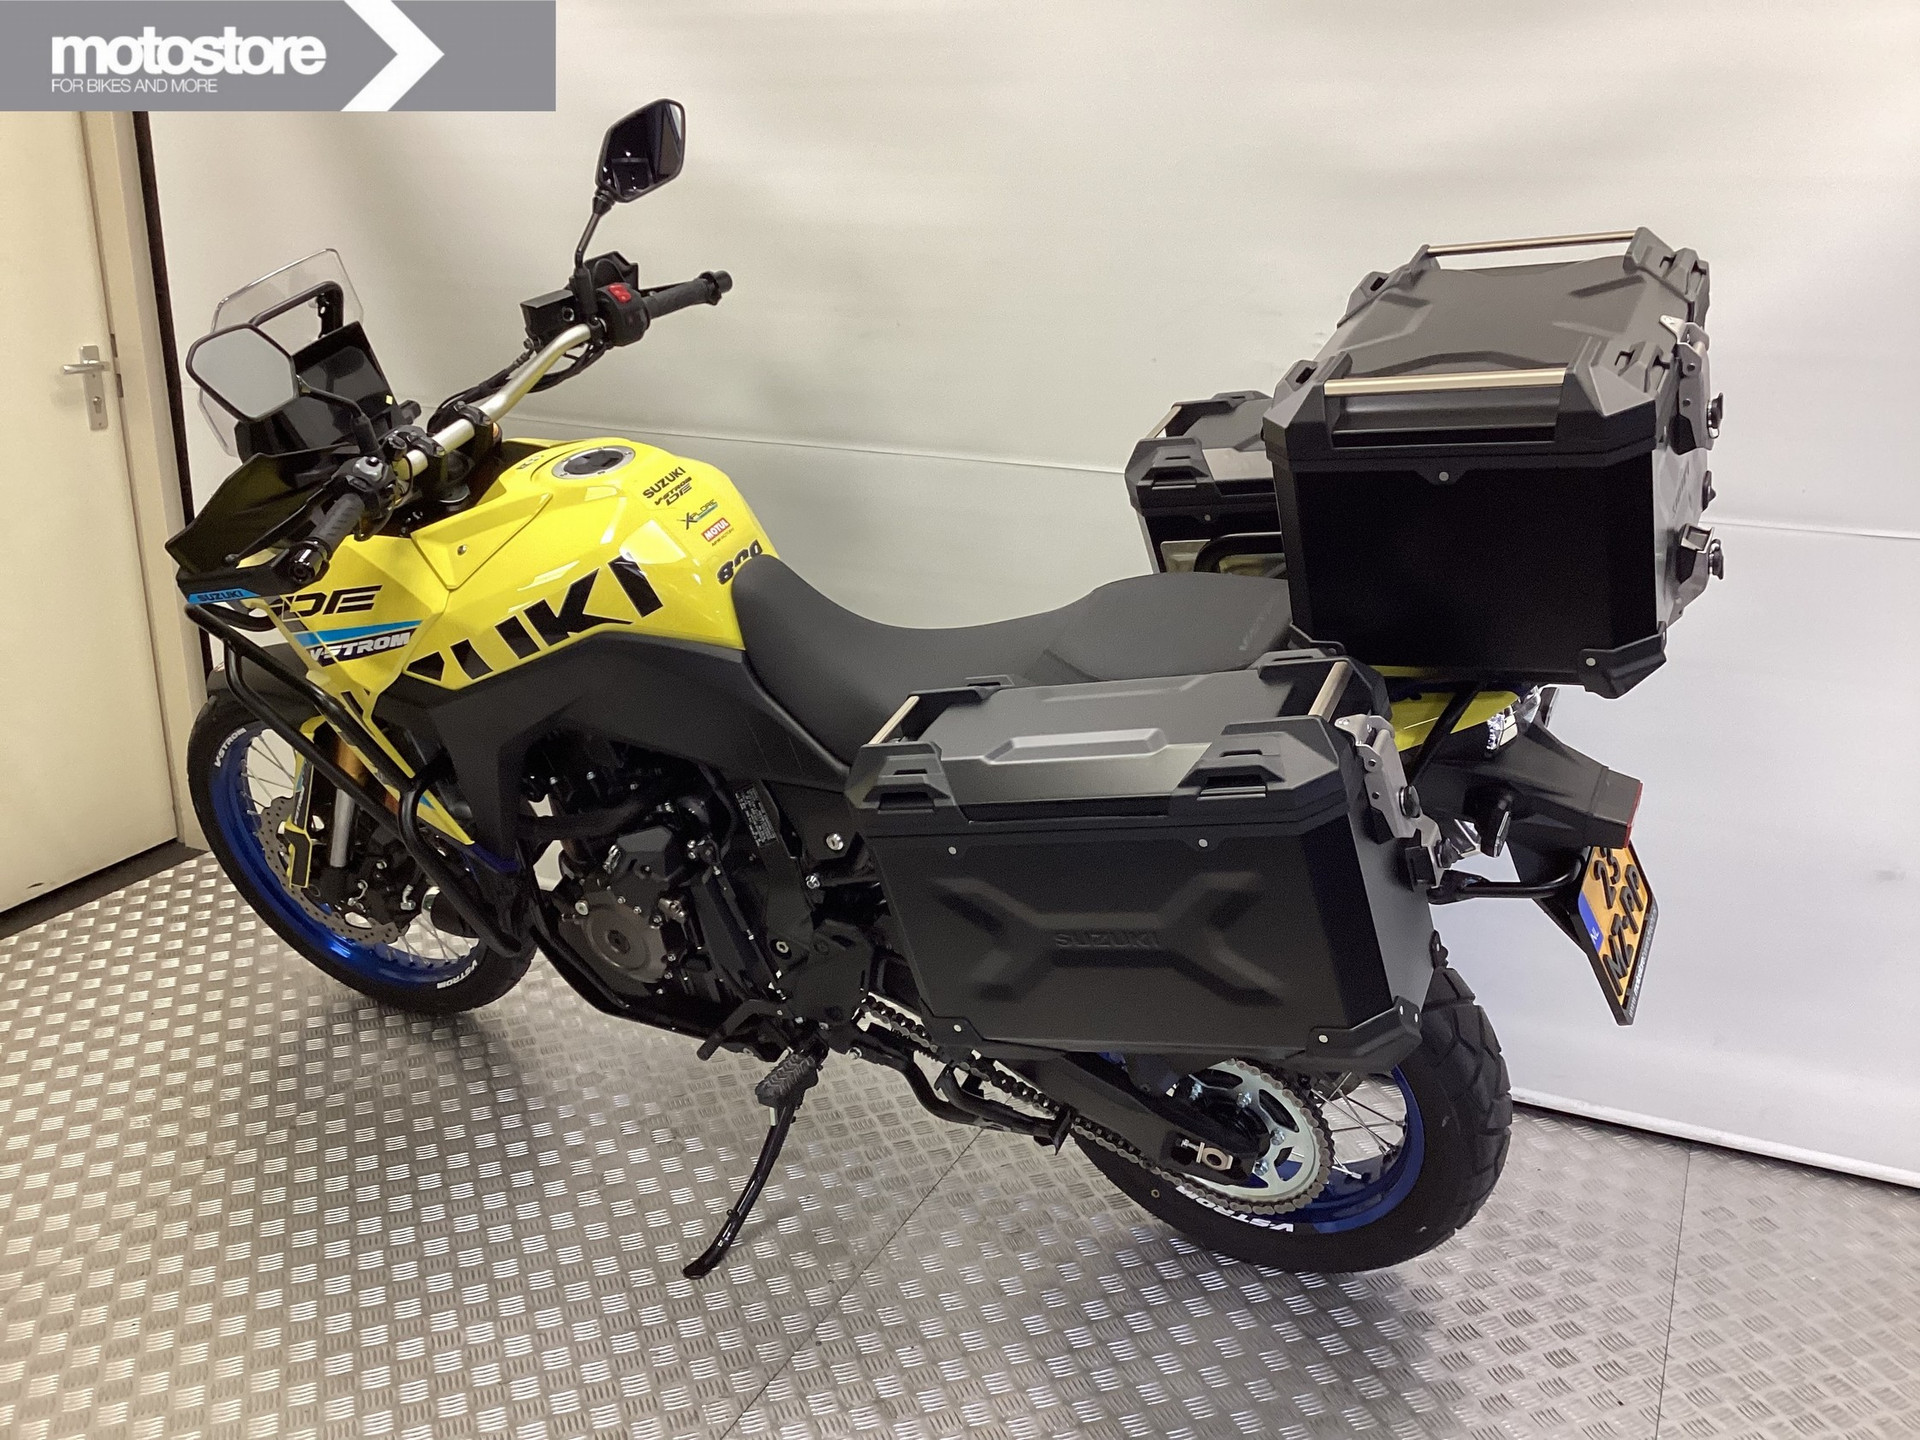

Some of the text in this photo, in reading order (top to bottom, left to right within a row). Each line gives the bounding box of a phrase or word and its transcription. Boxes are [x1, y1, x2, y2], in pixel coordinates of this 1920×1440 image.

[642, 466, 686, 499] SUZUKI
[703, 519, 729, 540] MOTUL
[197, 589, 244, 602] SUZUKI
[1055, 931, 1159, 949] SUZUKI
